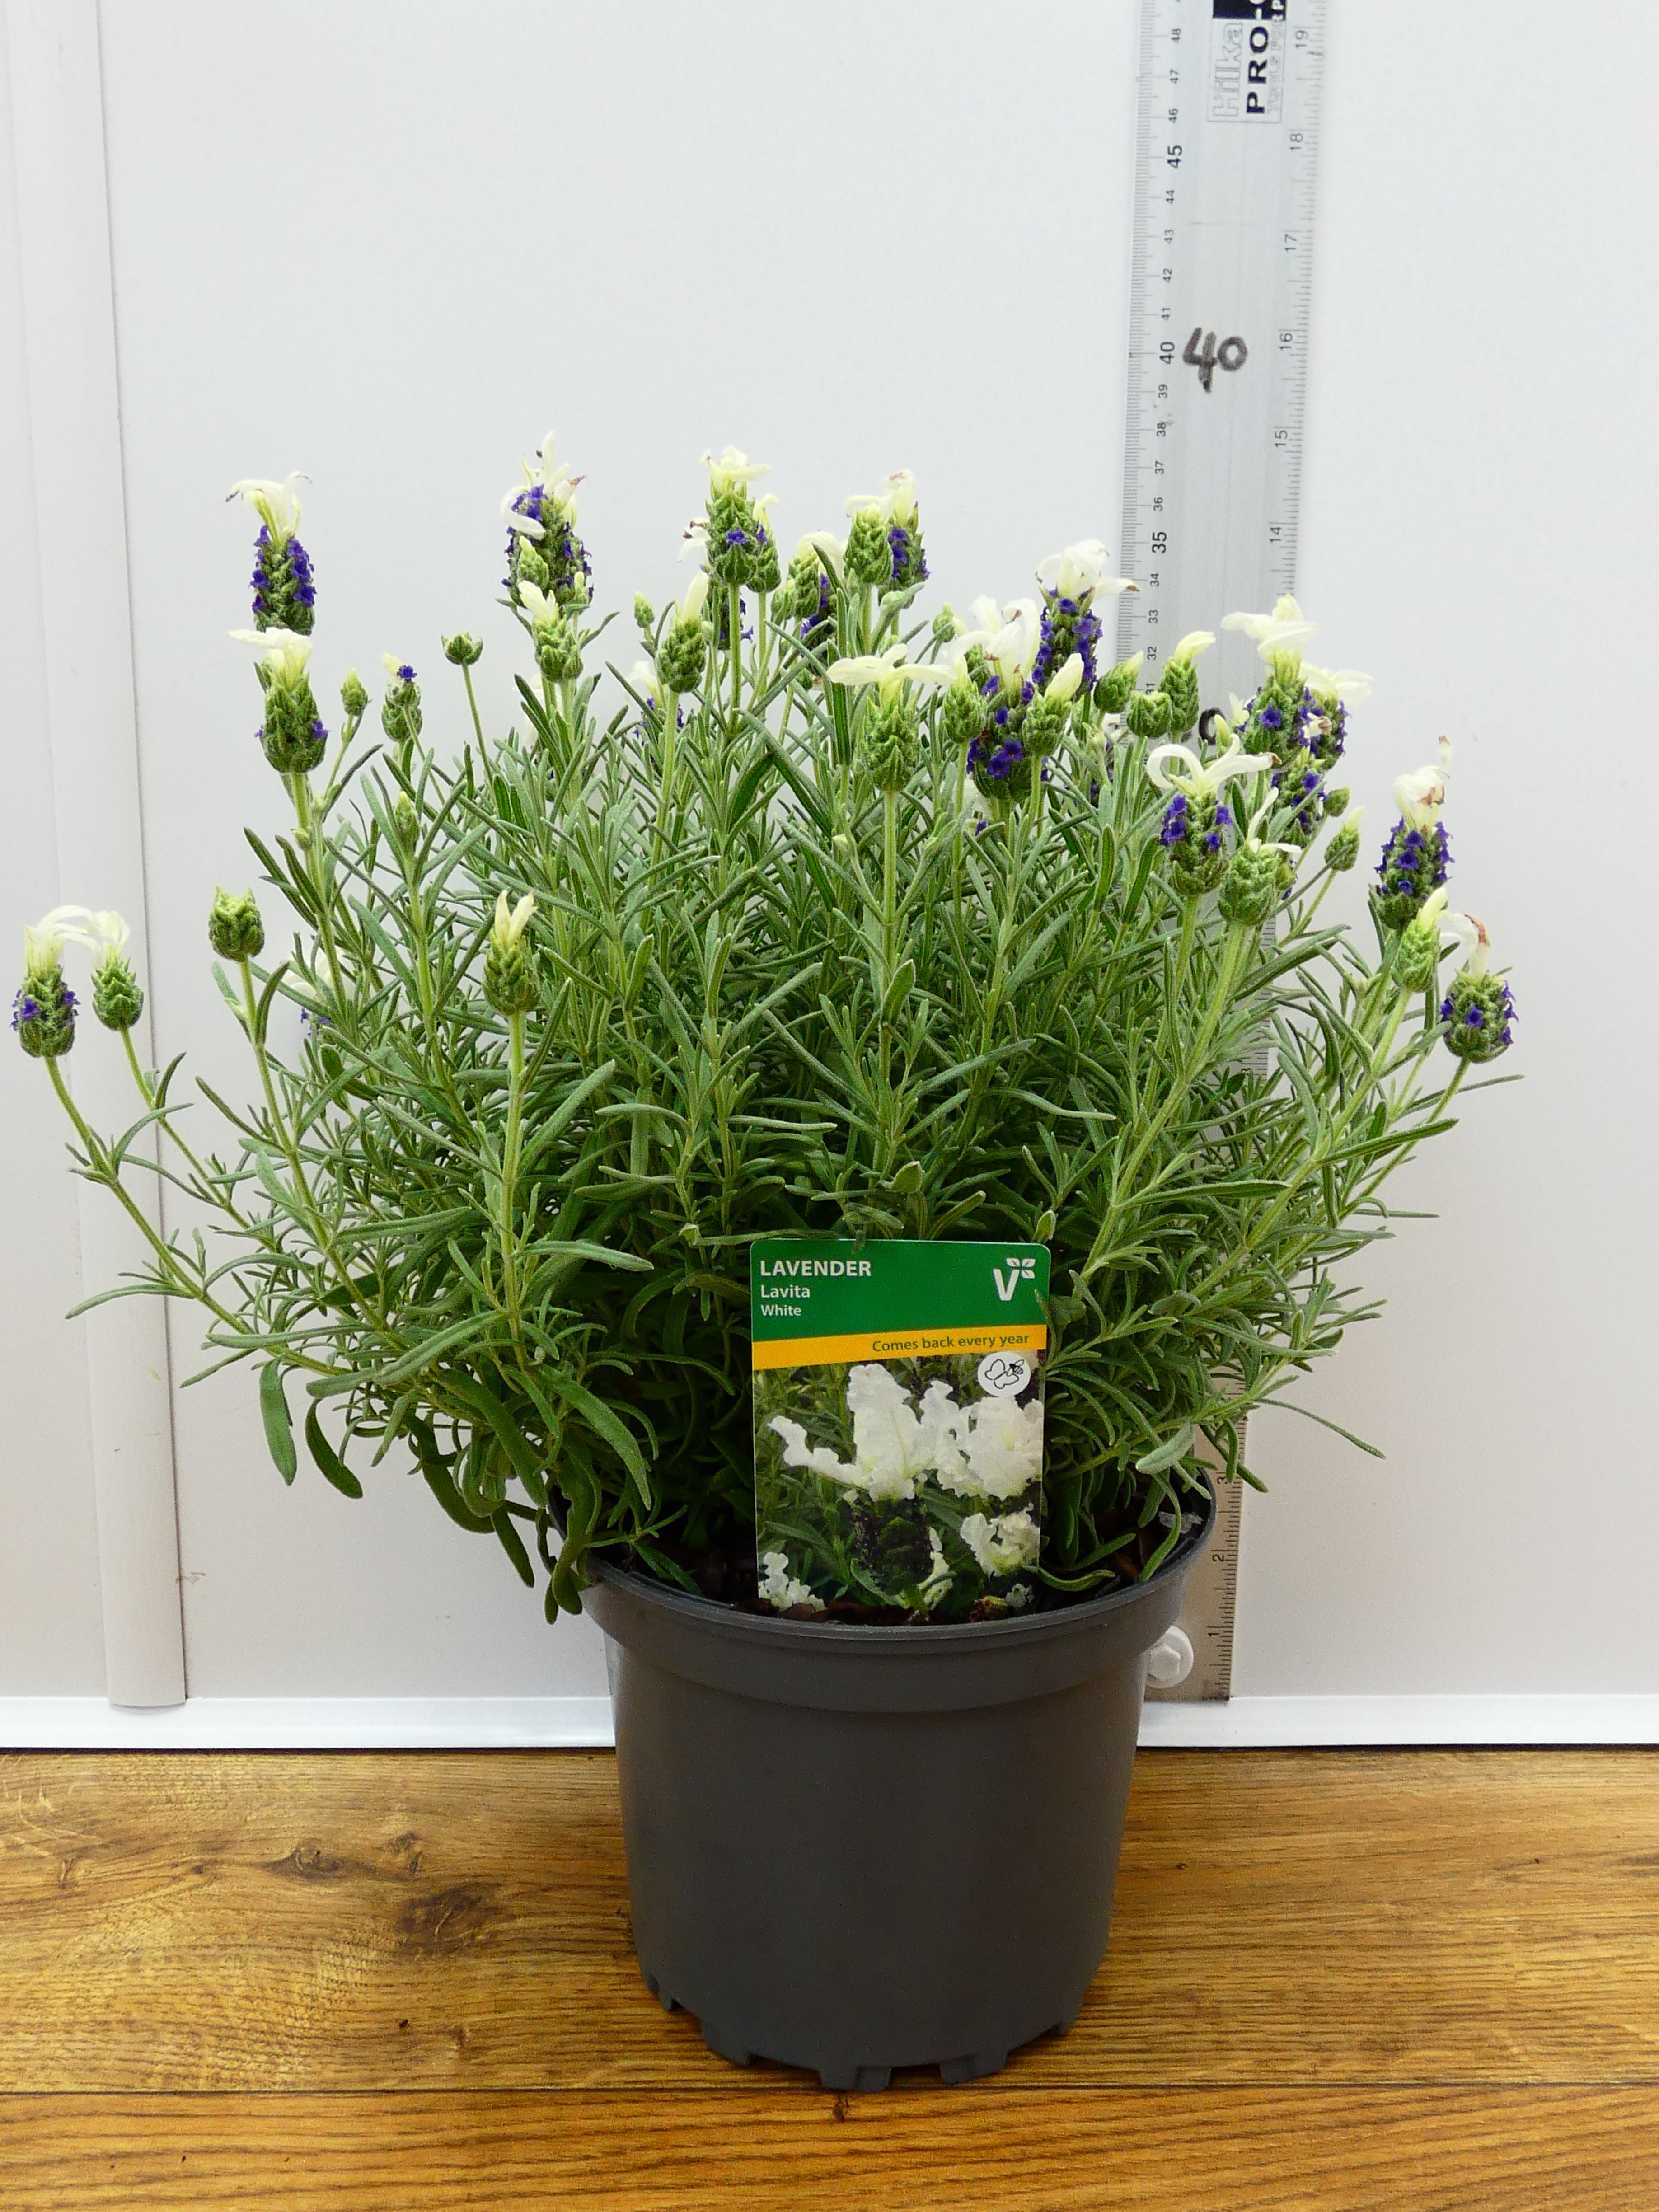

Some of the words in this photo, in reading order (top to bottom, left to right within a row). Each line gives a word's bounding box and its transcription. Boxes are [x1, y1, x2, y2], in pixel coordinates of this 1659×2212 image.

[1171, 28, 1181, 43] 48
[1295, 30, 1308, 48] 19
[1246, 0, 1269, 113] PRO-
[1170, 70, 1179, 84] 47
[1213, 23, 1242, 116] Hilka
[1168, 108, 1178, 123] 46
[1290, 133, 1303, 150] 18
[1167, 145, 1182, 169] 45
[1165, 190, 1175, 205] 44
[1164, 229, 1174, 244] 43
[1284, 234, 1297, 252] 17
[1162, 268, 1172, 283] 42
[1161, 307, 1171, 320] 41
[1279, 333, 1293, 350] 16
[1160, 342, 1175, 364] 40
[1182, 327, 1248, 394] 40
[1158, 384, 1168, 398] 39
[1157, 422, 1166, 436] 38
[1275, 430, 1288, 448] 15
[1155, 461, 1164, 475] 37
[1153, 497, 1163, 511] 36
[1269, 527, 1282, 543] 14
[1152, 532, 1167, 554] 35
[1150, 573, 1160, 587] 34
[1148, 609, 1158, 623] 33
[1147, 646, 1157, 660] 32
[760, 1260, 872, 1277] LAVENDER
[761, 1284, 810, 1298] Lavita
[761, 1304, 801, 1317] White
[872, 1340, 918, 1352] Comes
[922, 1336, 954, 1349] back
[958, 1335, 996, 1348] every
[999, 1334, 1029, 1347] year
[1217, 1476, 1228, 1485] 3
[1212, 1554, 1224, 1562] 2
